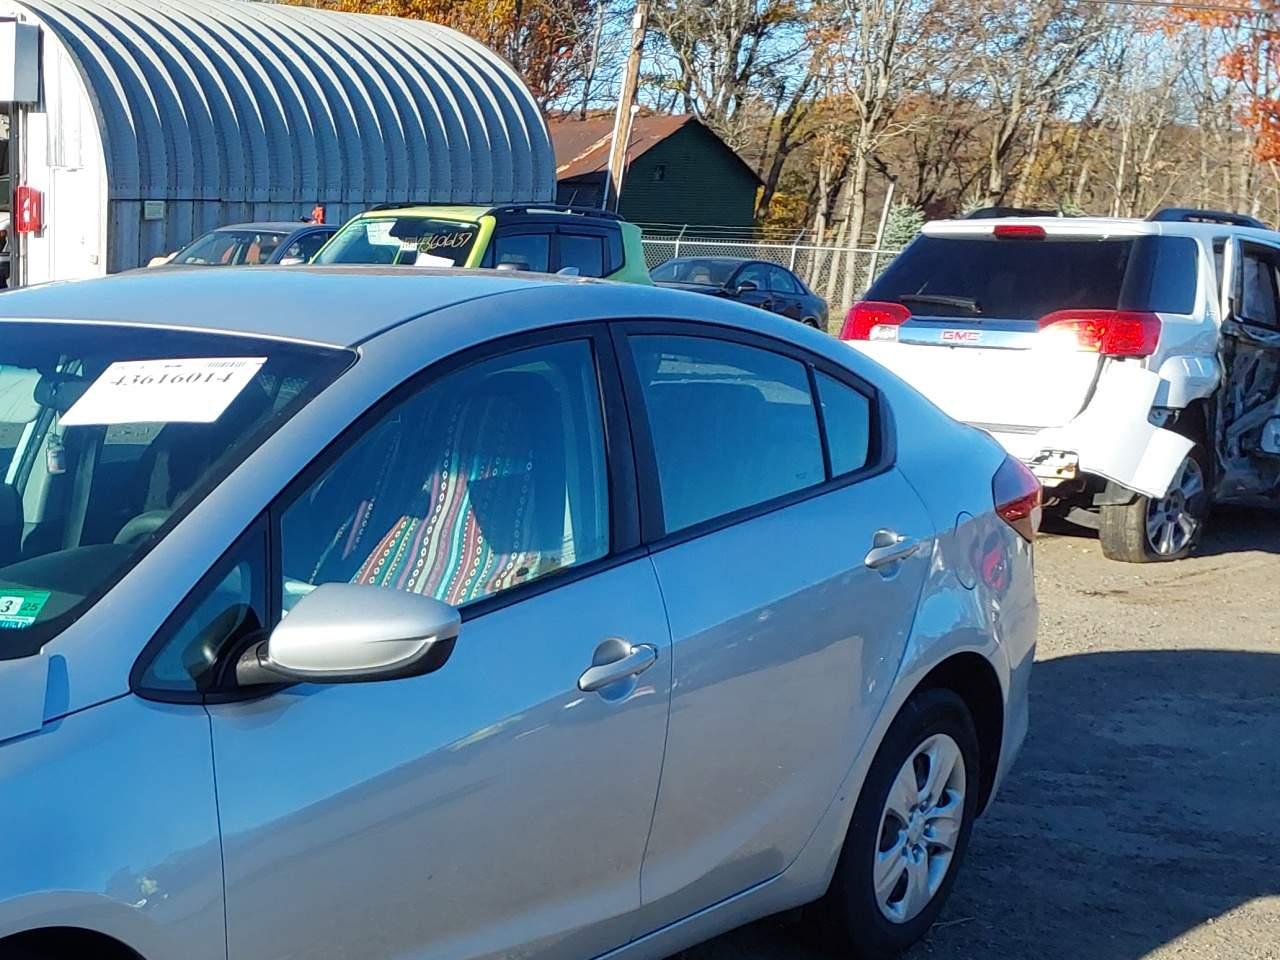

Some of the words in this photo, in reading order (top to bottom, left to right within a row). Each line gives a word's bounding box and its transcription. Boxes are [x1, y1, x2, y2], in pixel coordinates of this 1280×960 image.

[942, 330, 980, 340] GMC
[110, 370, 235, 387] 43616014
[0, 599, 14, 613] 3
